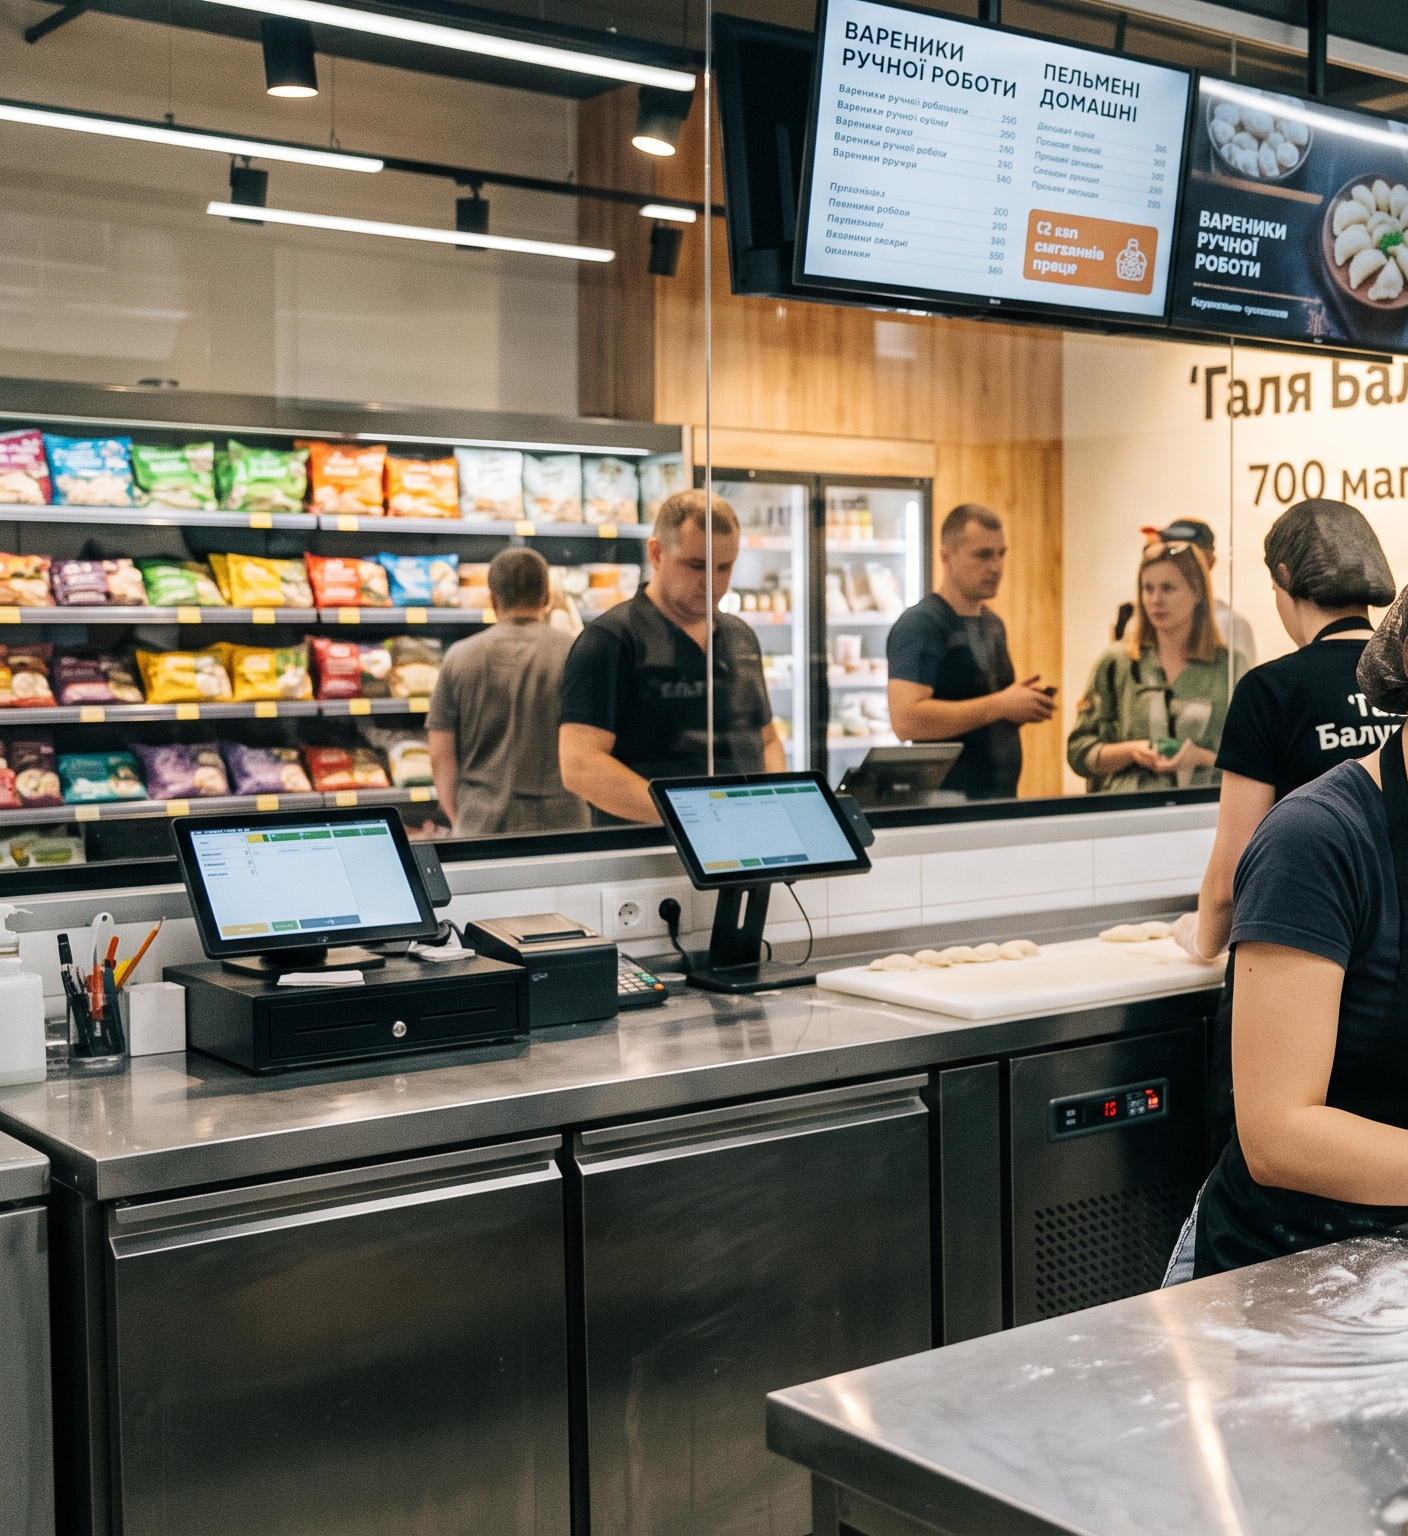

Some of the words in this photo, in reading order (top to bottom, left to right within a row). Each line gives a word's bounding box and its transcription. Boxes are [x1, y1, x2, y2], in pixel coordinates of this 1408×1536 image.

[845, 21, 964, 62] ВАРЕНИКИ
[842, 49, 925, 81] РУЧНОЇ
[931, 66, 1017, 99] РОБОТИ
[1044, 64, 1141, 99] ПЕЛЬМЕНІ
[839, 84, 886, 100] Вареники
[837, 100, 884, 116] Вареники
[1039, 89, 1138, 123] ДОМАШНІ
[835, 116, 883, 132] Вареники
[834, 132, 880, 147] Вареники
[832, 148, 880, 163] Вареники
[1199, 210, 1287, 240] ВАРЕНИКИ
[1197, 232, 1260, 257] РУЧНОЇ
[1195, 253, 1261, 278] РОБОТИ
[1189, 364, 1312, 421] 'Галя
[1249, 459, 1326, 506] 700
